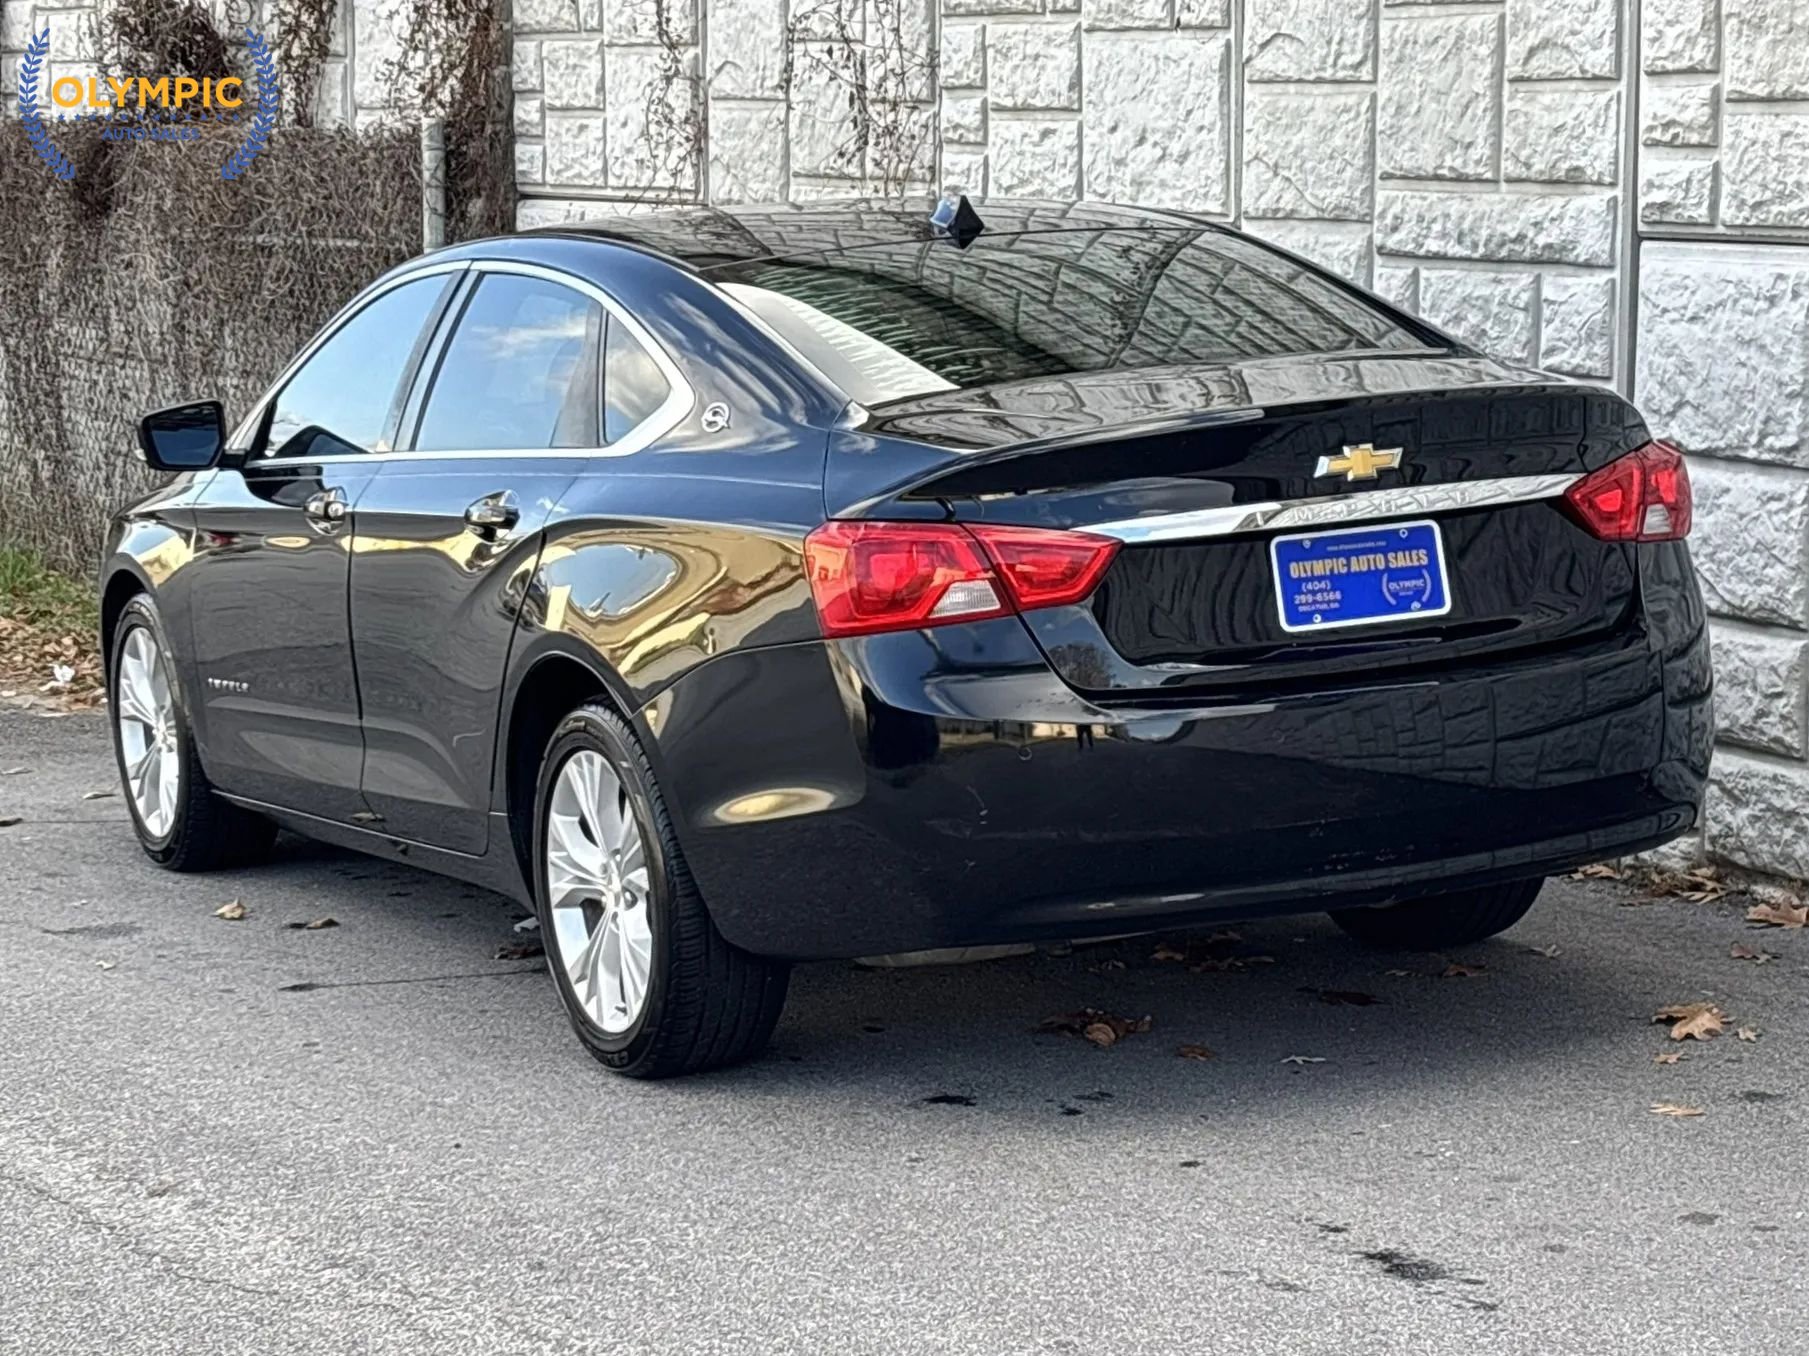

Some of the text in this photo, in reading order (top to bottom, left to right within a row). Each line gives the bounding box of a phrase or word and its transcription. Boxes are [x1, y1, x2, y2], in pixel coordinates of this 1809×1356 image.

[1290, 549, 1428, 578] OLYMPIC AUTO SALES
[1302, 581, 1330, 592] (404)
